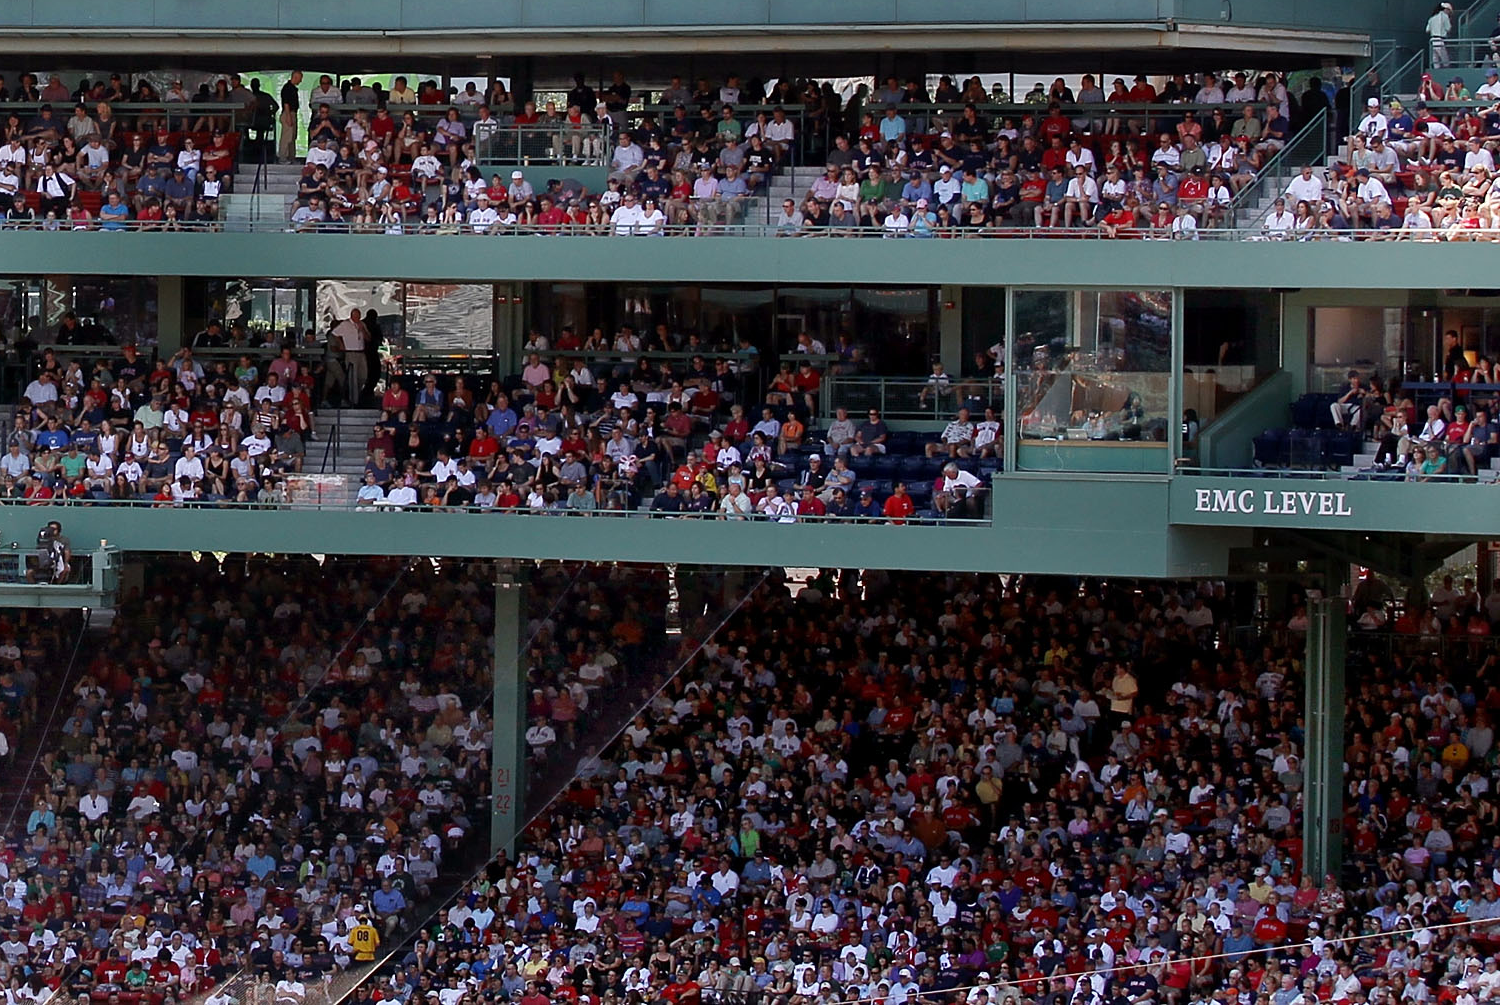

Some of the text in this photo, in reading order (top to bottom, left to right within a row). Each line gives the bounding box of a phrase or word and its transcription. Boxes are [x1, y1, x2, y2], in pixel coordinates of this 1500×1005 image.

[1195, 489, 1352, 516] EMC LEVEL
[497, 768, 510, 783] 21
[496, 794, 511, 810] 22
[357, 930, 368, 941] 08
